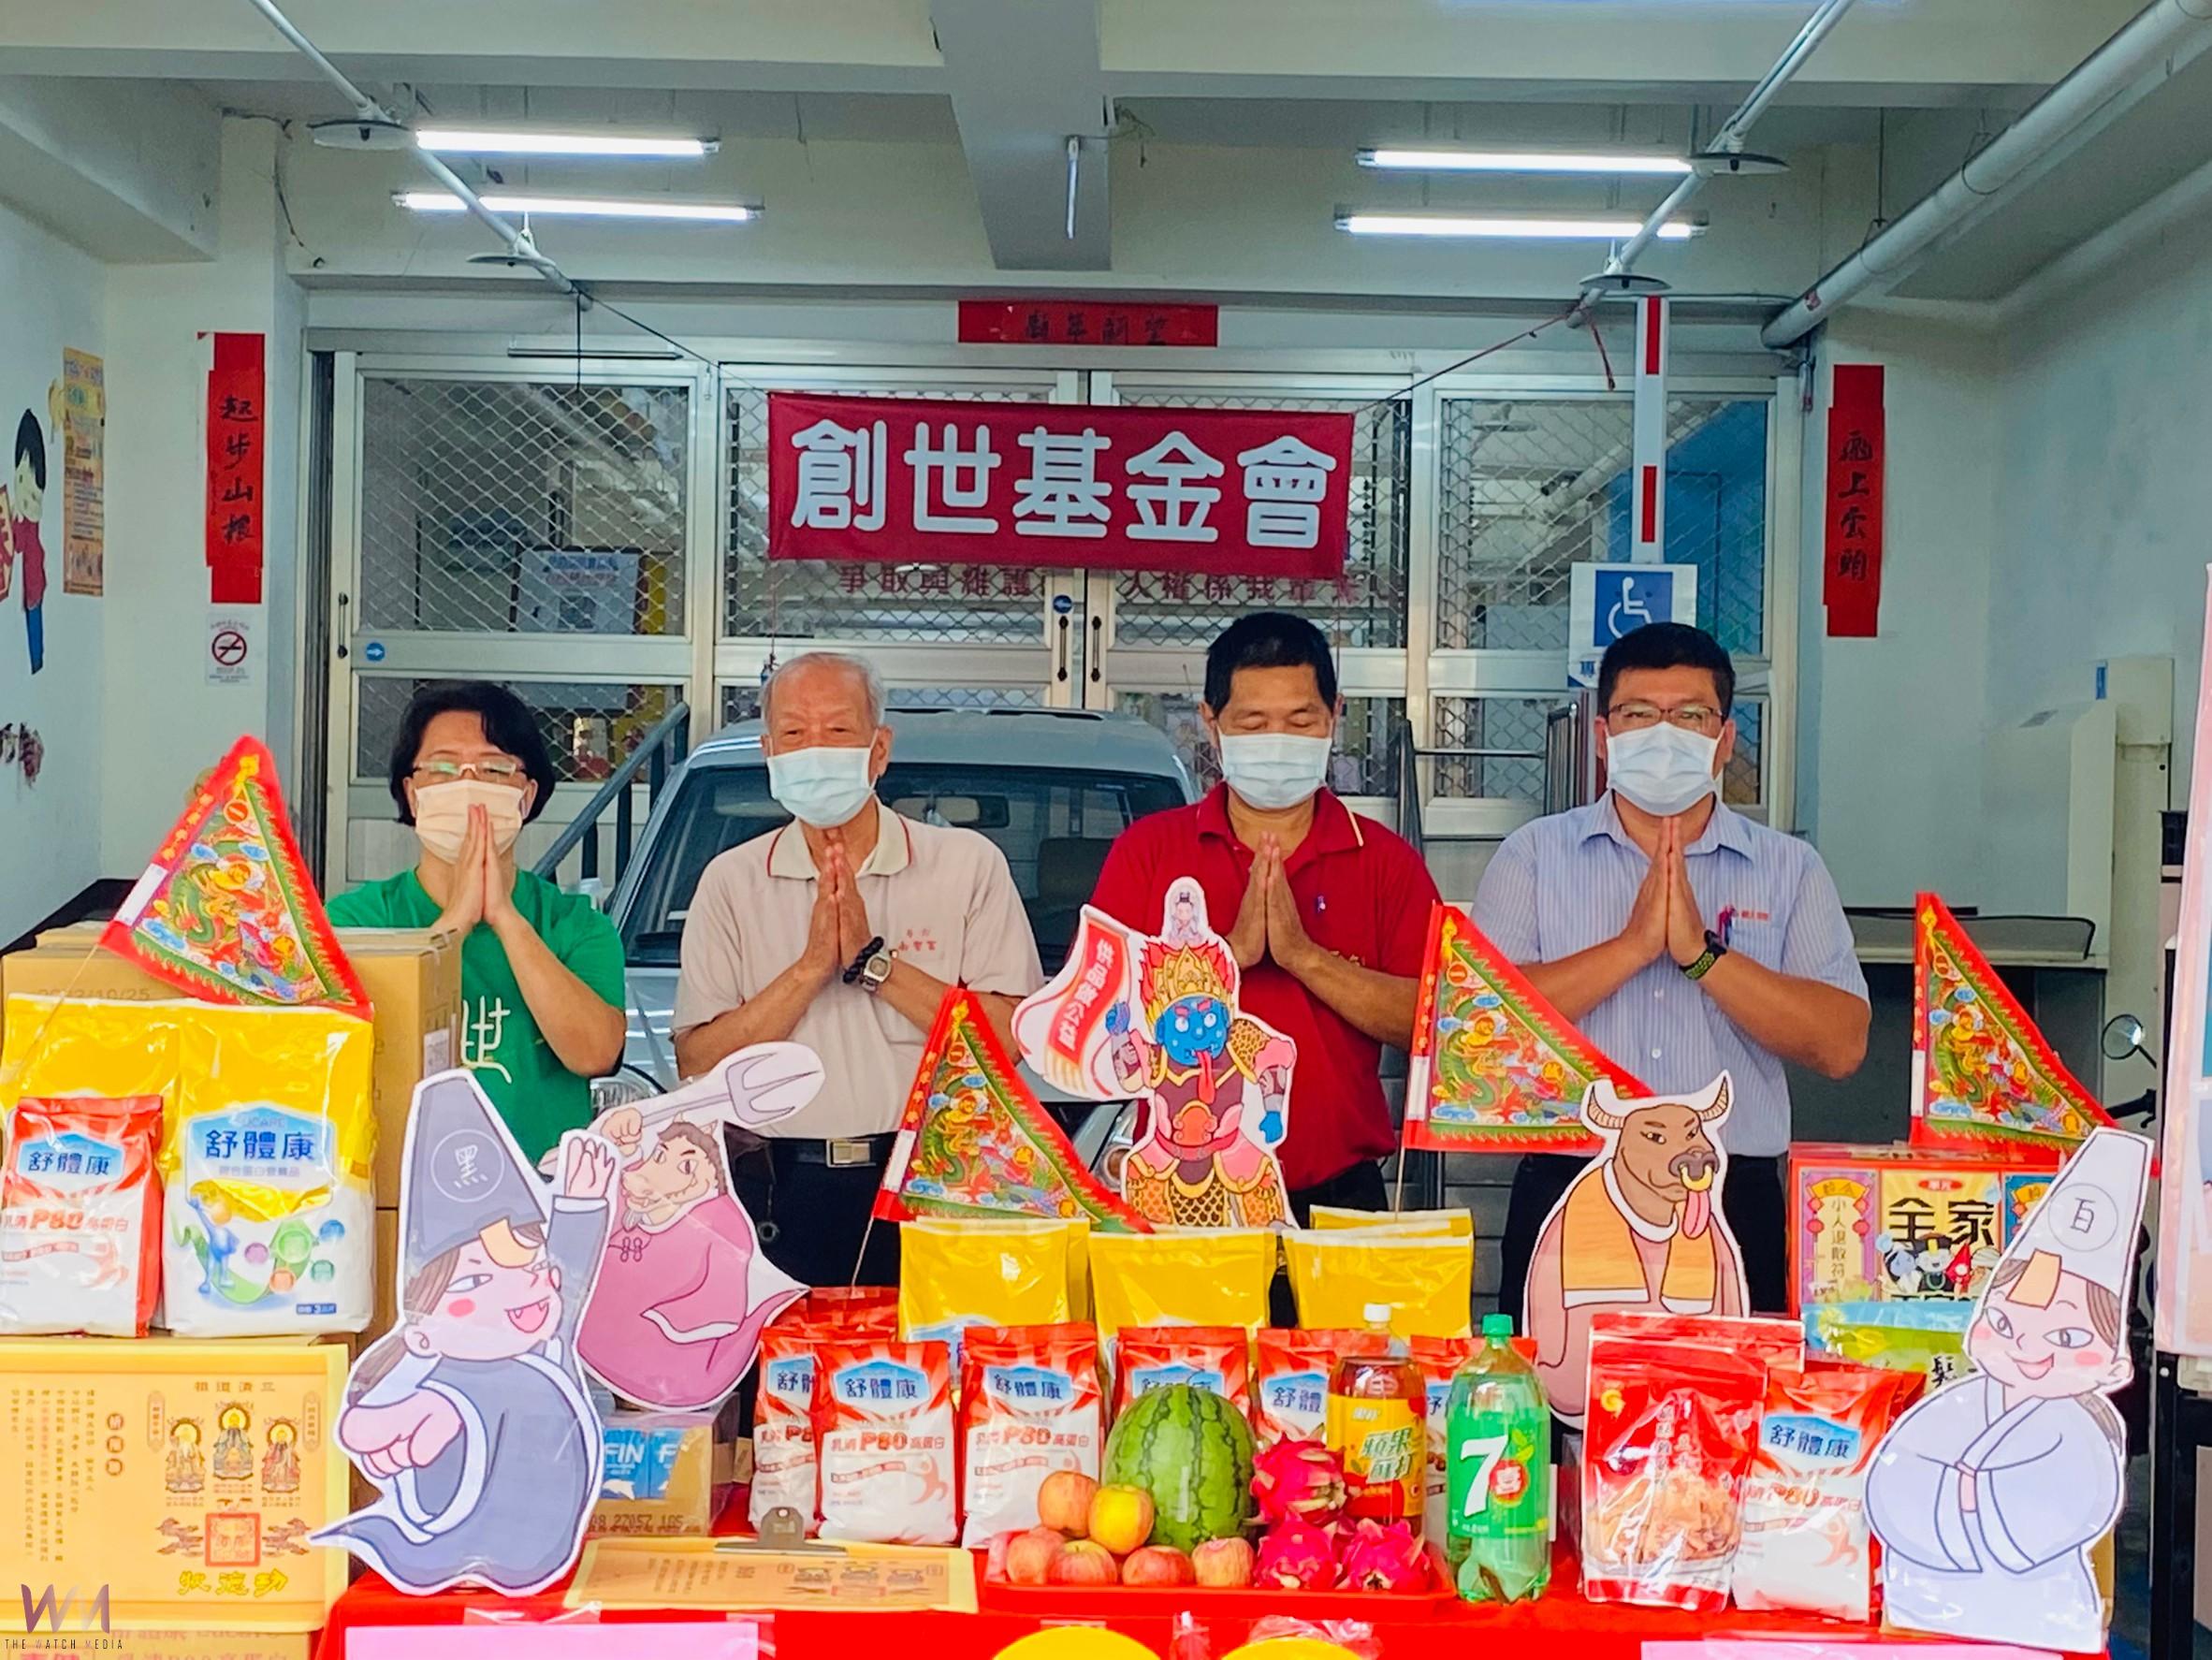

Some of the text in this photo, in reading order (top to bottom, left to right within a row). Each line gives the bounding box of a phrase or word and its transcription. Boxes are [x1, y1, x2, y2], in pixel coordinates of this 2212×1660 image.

[789, 417, 1338, 550] 創世基金會
[1057, 939, 1115, 1053] 供品做公益
[460, 995, 513, 1085] 世
[27, 1150, 113, 1176] 舒體康
[205, 1129, 315, 1161] 舒體康
[452, 1143, 489, 1190] 黑
[1830, 1197, 1847, 1279] 小人退散符
[1887, 1197, 1995, 1247] 全家
[844, 1376, 919, 1400] 舒體康
[994, 1374, 1063, 1401] 舒體康
[1768, 1423, 1851, 1460] 舒體康
